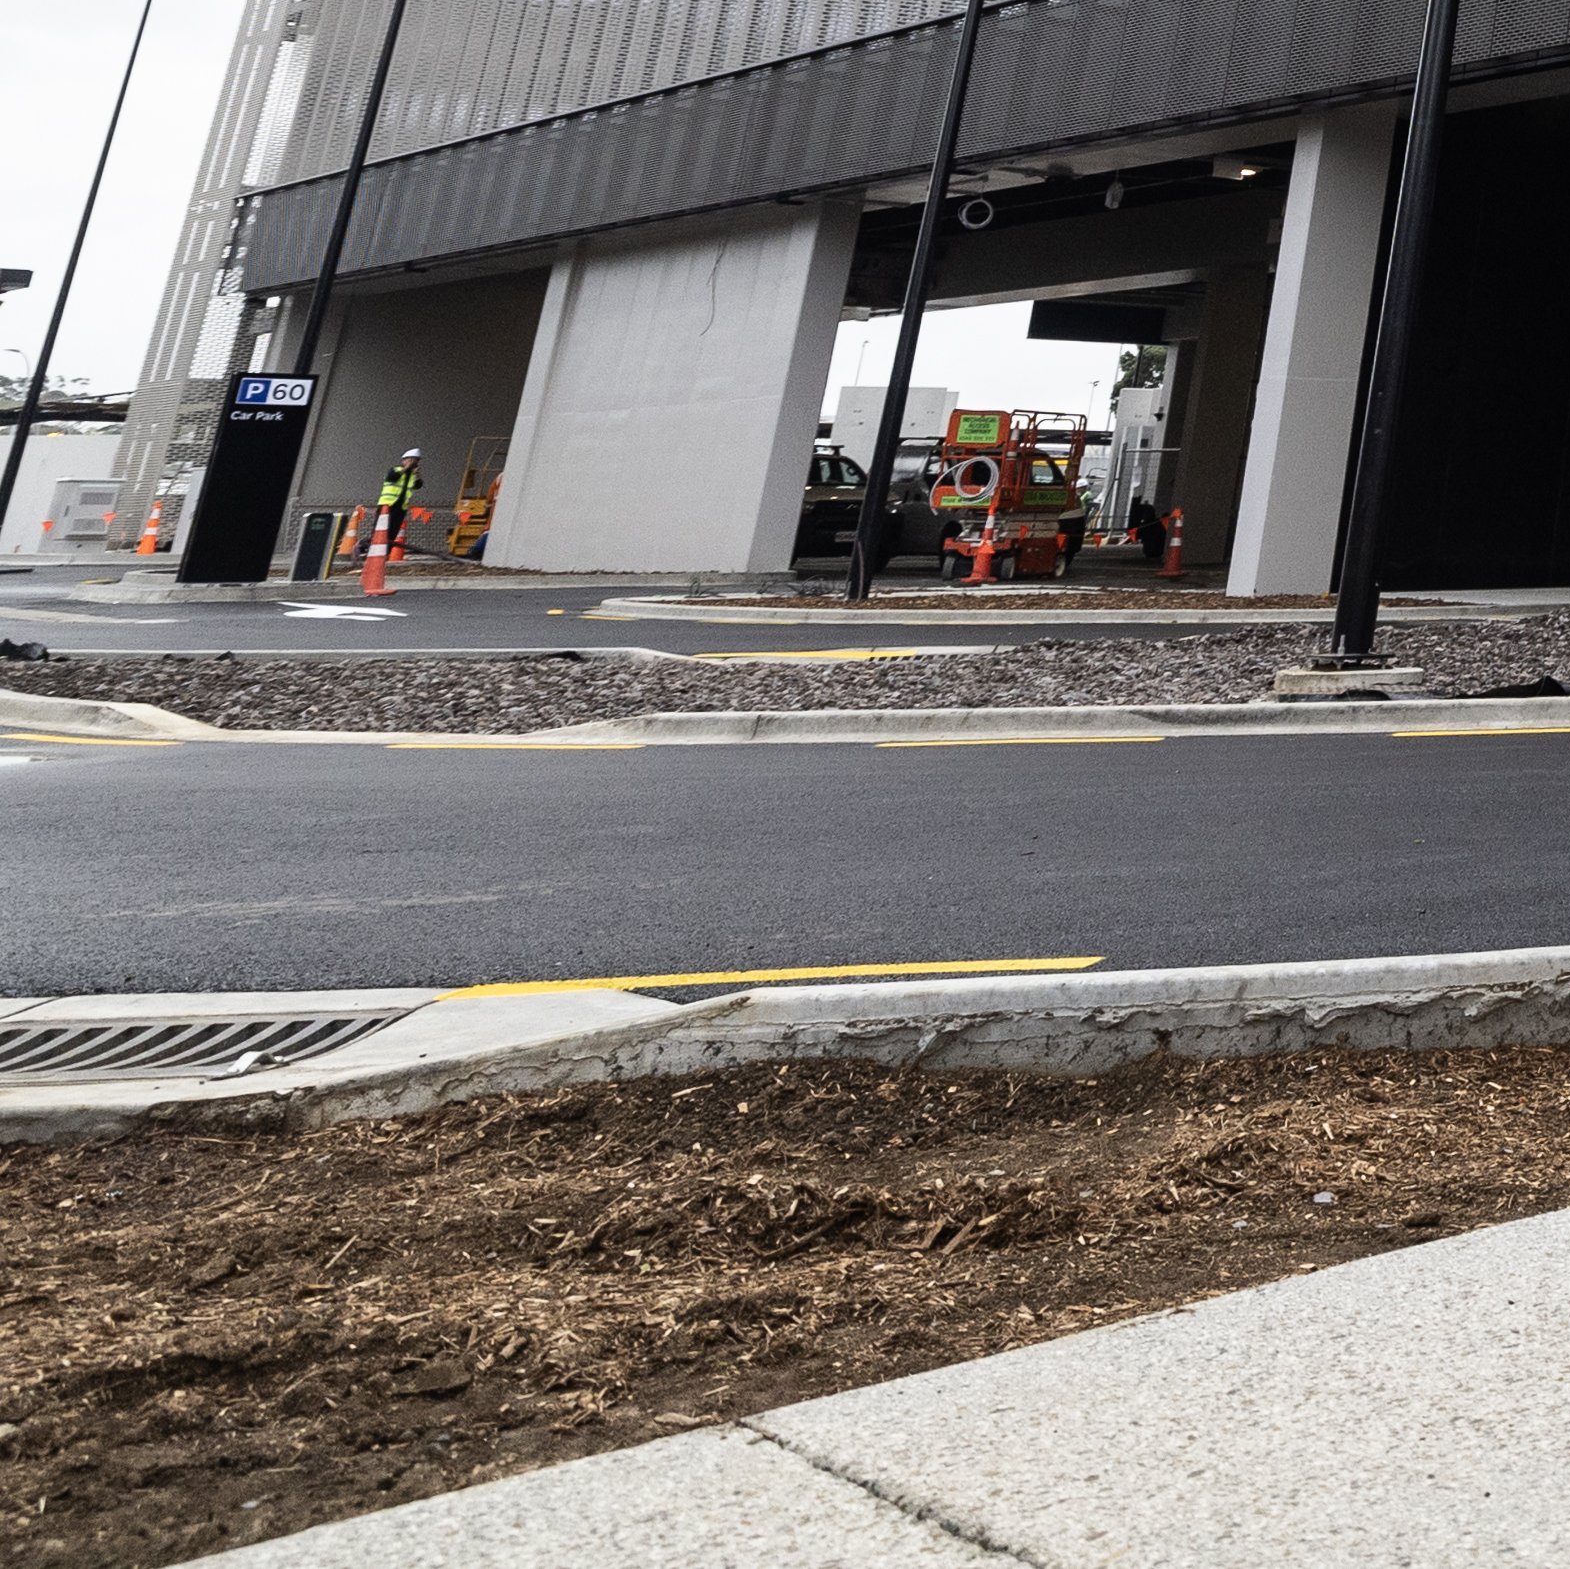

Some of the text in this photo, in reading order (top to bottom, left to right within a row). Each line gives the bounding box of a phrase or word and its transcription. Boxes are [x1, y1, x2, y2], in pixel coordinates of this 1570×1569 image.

[245, 382, 305, 401] P 60
[230, 411, 285, 421] Car Park
